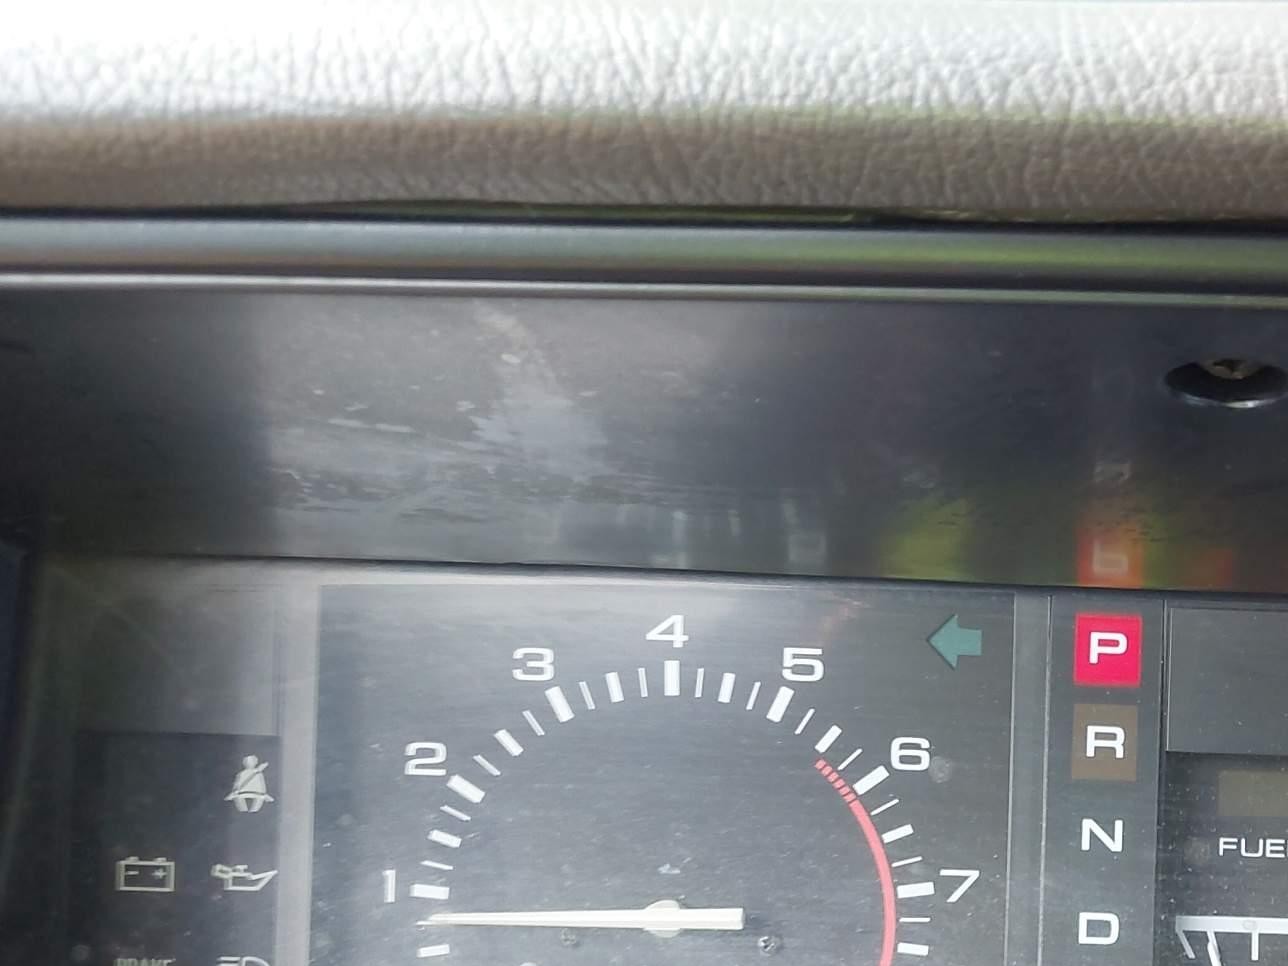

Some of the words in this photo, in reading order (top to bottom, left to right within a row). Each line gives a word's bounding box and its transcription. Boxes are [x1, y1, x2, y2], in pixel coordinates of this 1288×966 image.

[646, 614, 689, 648] 4
[1088, 631, 1128, 665] P
[512, 647, 555, 681] 3
[781, 647, 824, 682] 5
[890, 736, 931, 771] 6
[1085, 725, 1126, 759] R
[404, 742, 448, 777] 2
[1081, 818, 1123, 853] N
[382, 869, 396, 903] 1
[939, 869, 980, 903] 7
[1078, 911, 1120, 945] D
